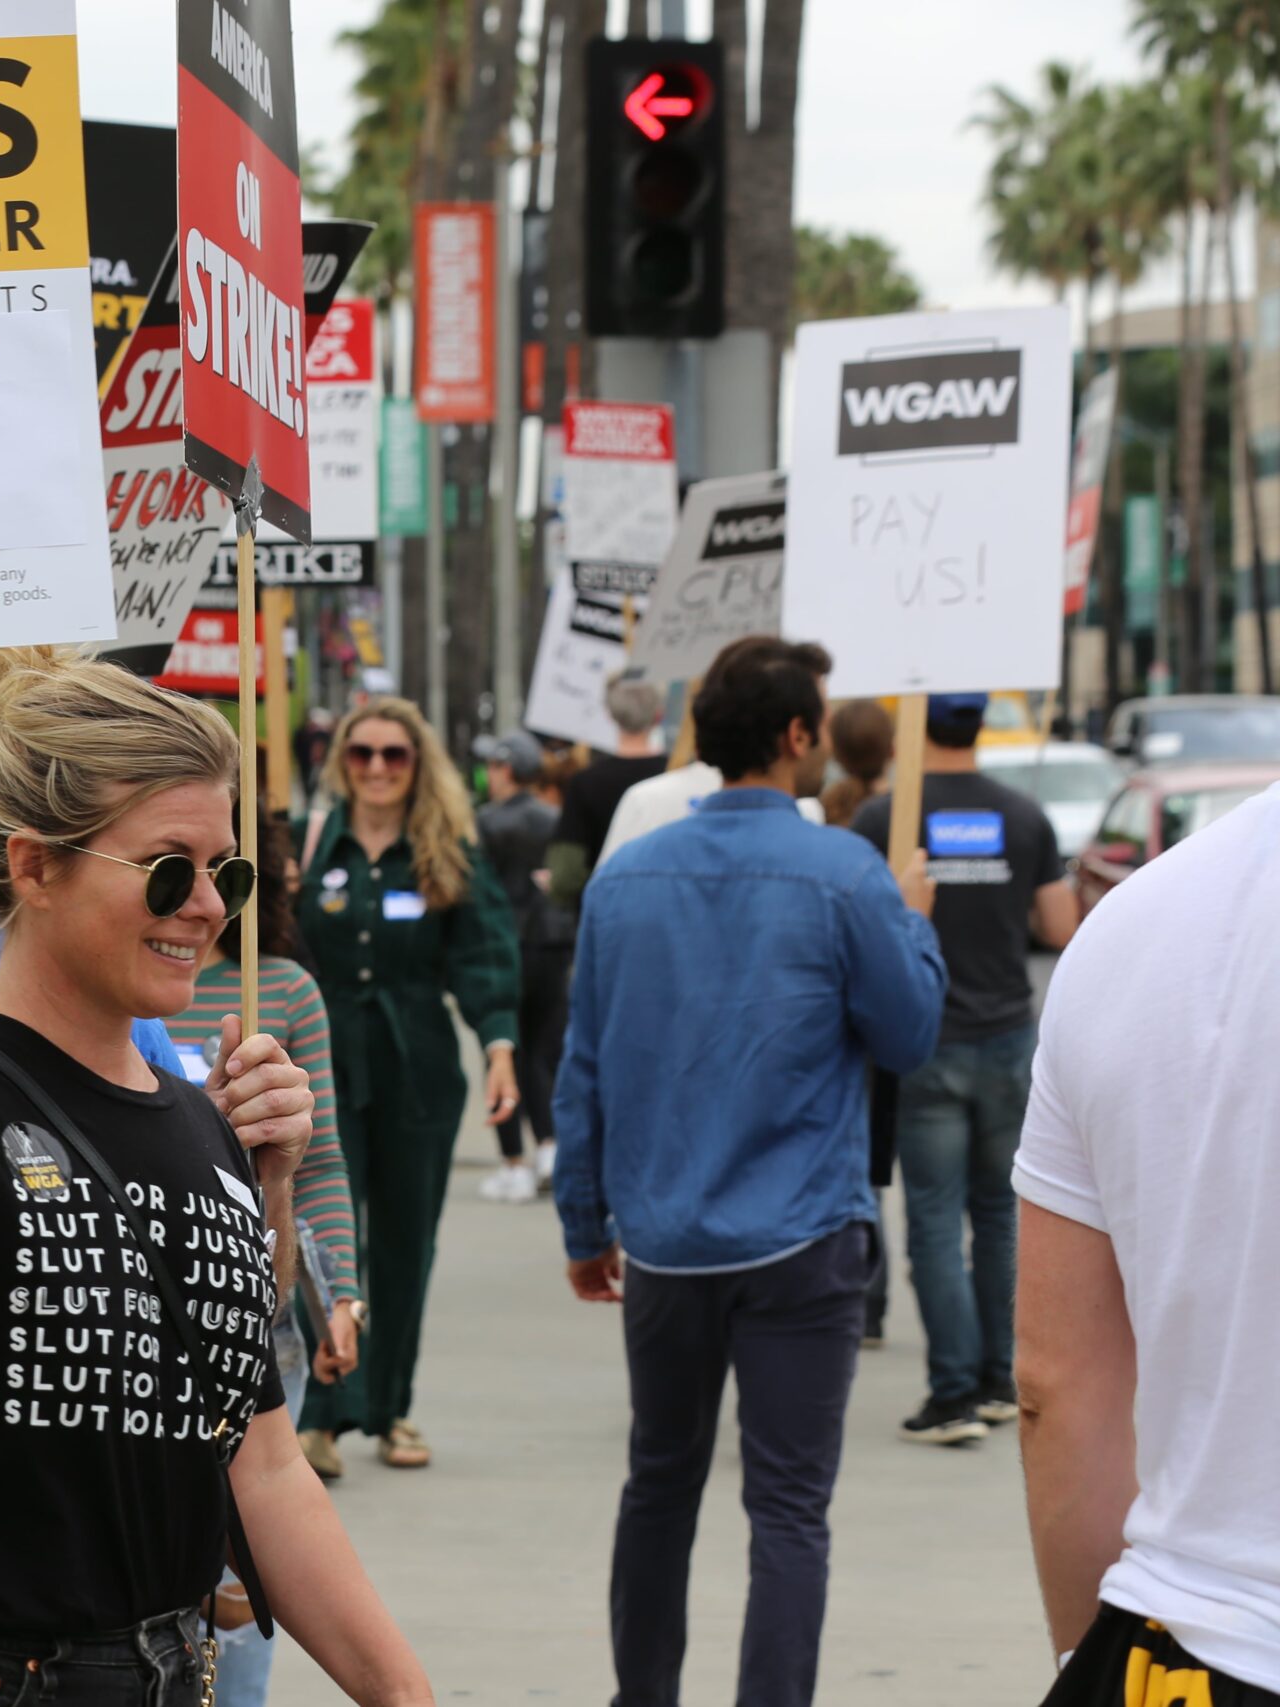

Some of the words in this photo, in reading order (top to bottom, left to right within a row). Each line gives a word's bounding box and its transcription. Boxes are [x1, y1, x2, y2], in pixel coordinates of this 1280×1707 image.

[211, 0, 273, 119] AMERICA
[236, 161, 261, 250] ON
[186, 228, 305, 438] STRIKE!
[844, 376, 1018, 427] WGAW
[850, 491, 942, 546] PAY
[158, 527, 221, 570] NOT
[0, 568, 26, 584] any
[4, 586, 51, 606] goods.
[894, 541, 988, 608] US!
[23, 1173, 66, 1189] WGA
[13, 1177, 92, 1204] ST
[108, 1182, 167, 1212] OR
[182, 1191, 266, 1244] JUSTI
[16, 1247, 106, 1274] SLUT
[120, 1247, 154, 1282] FO
[19, 1212, 100, 1239] SLUT
[114, 1212, 167, 1248] FR
[185, 1225, 277, 1285] JUSTIC
[9, 1286, 111, 1316] SLUT
[124, 1287, 162, 1325] FOR
[9, 1327, 114, 1355] SLUT
[123, 1330, 160, 1363] FOR
[6, 1363, 112, 1394] SLUT
[123, 1370, 160, 1400] FO
[4, 1399, 110, 1432] SLUT
